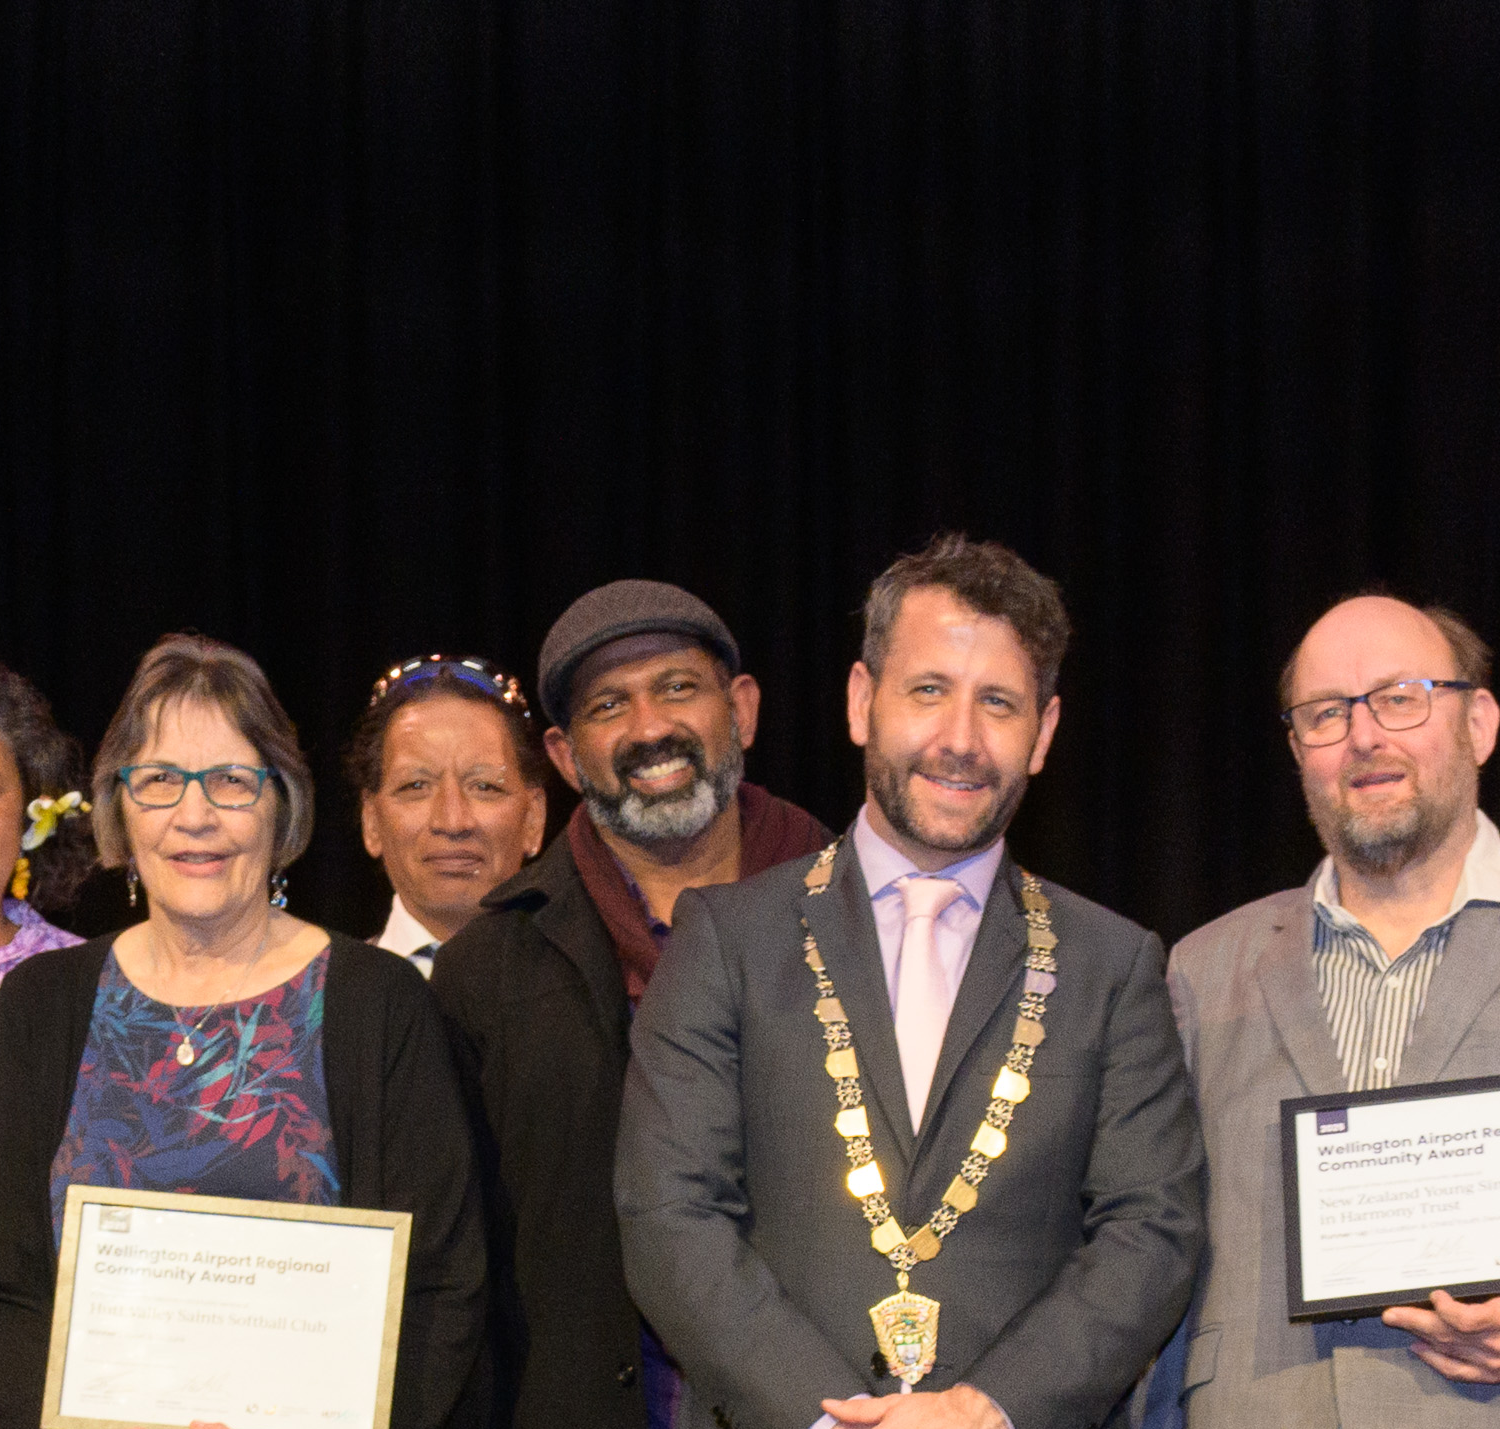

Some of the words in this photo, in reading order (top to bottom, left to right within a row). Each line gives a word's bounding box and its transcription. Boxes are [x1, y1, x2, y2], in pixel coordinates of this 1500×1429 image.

[1318, 1140, 1412, 1156] Wellington
[1417, 1129, 1477, 1145] Airport
[1318, 1151, 1422, 1172] Community
[1428, 1144, 1484, 1160] Award
[1320, 1196, 1352, 1209] New
[1357, 1187, 1420, 1206] Zealand
[1424, 1181, 1474, 1198] Young
[1320, 1214, 1336, 1225] in
[1340, 1203, 1415, 1223] Harmony
[1421, 1201, 1460, 1214] Trust
[97, 1244, 189, 1264] Wellington
[192, 1251, 252, 1267] Airport
[256, 1255, 331, 1275] Regional
[94, 1261, 196, 1285] Community
[200, 1270, 257, 1286] Award
[178, 1310, 224, 1325] Saints
[228, 1312, 287, 1330] Softball
[290, 1319, 328, 1334] Club
